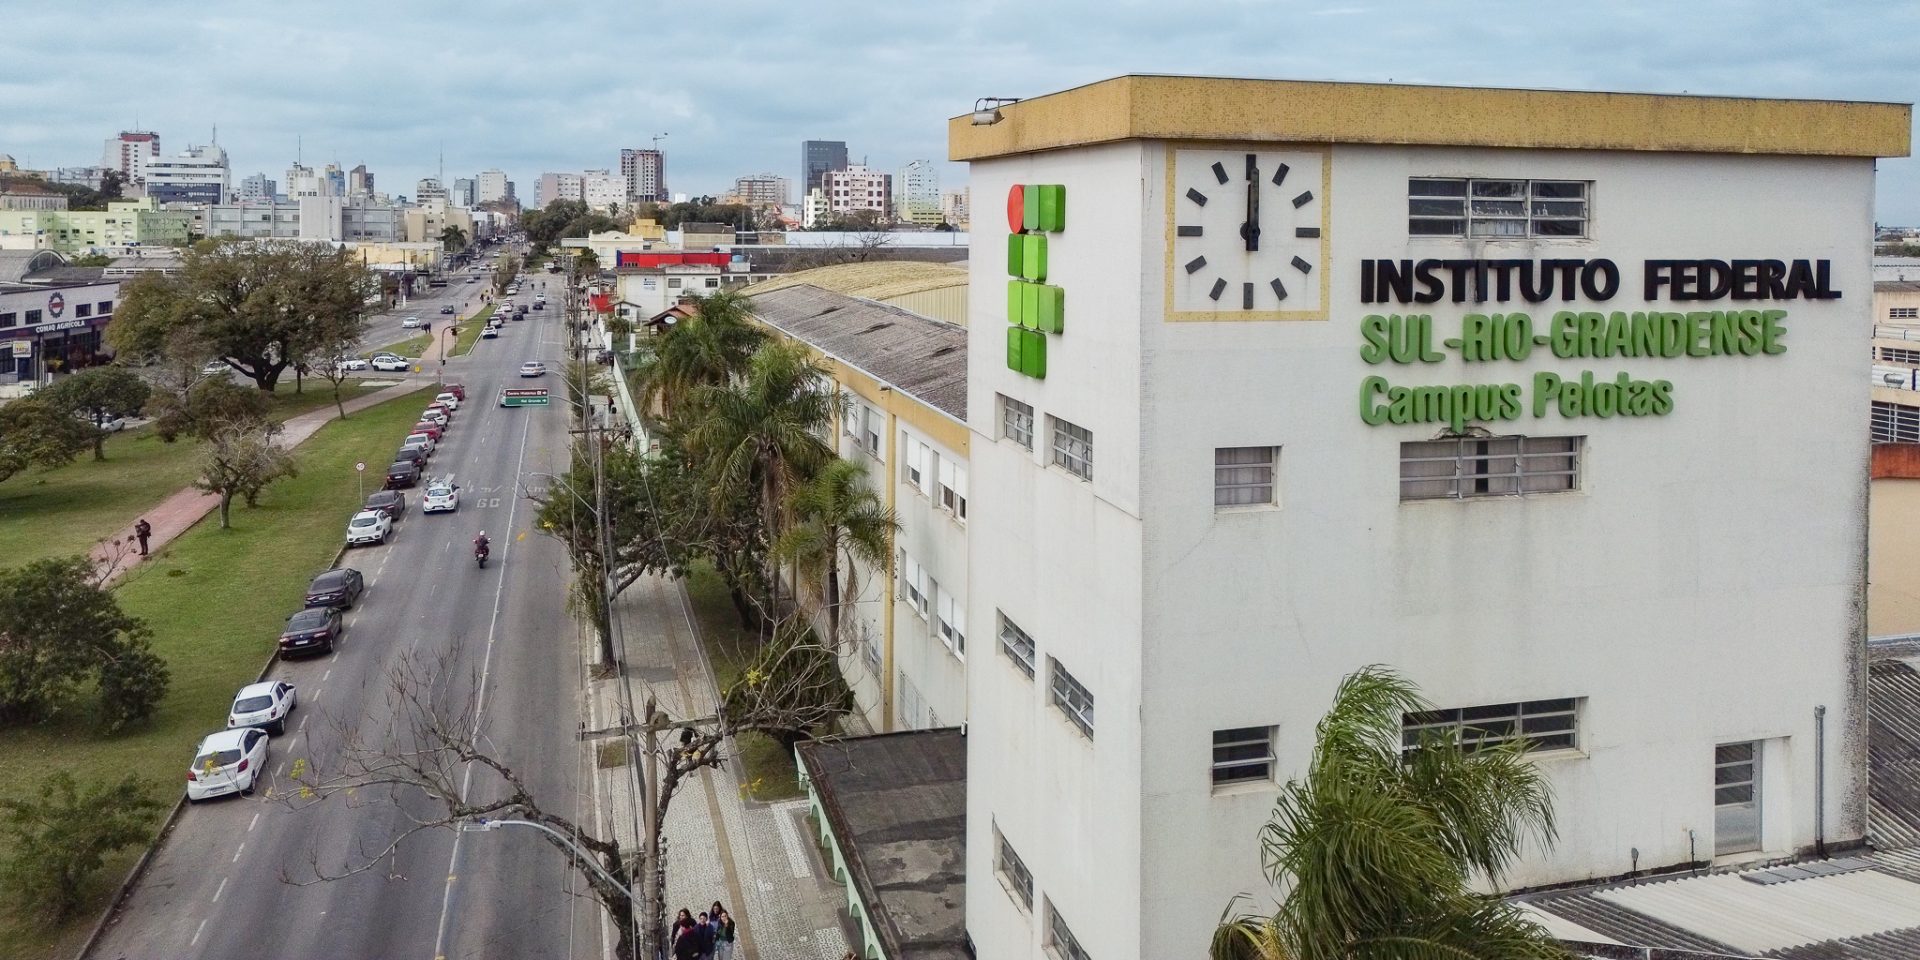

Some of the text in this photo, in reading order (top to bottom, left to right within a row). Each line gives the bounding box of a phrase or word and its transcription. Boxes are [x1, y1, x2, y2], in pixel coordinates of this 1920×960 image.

[1360, 258, 1842, 303] INSTITUTO FEDERAL
[1360, 309, 1788, 366] SUL-RIO-GRANDENSE
[1360, 371, 1674, 433] Campus Pelotas
